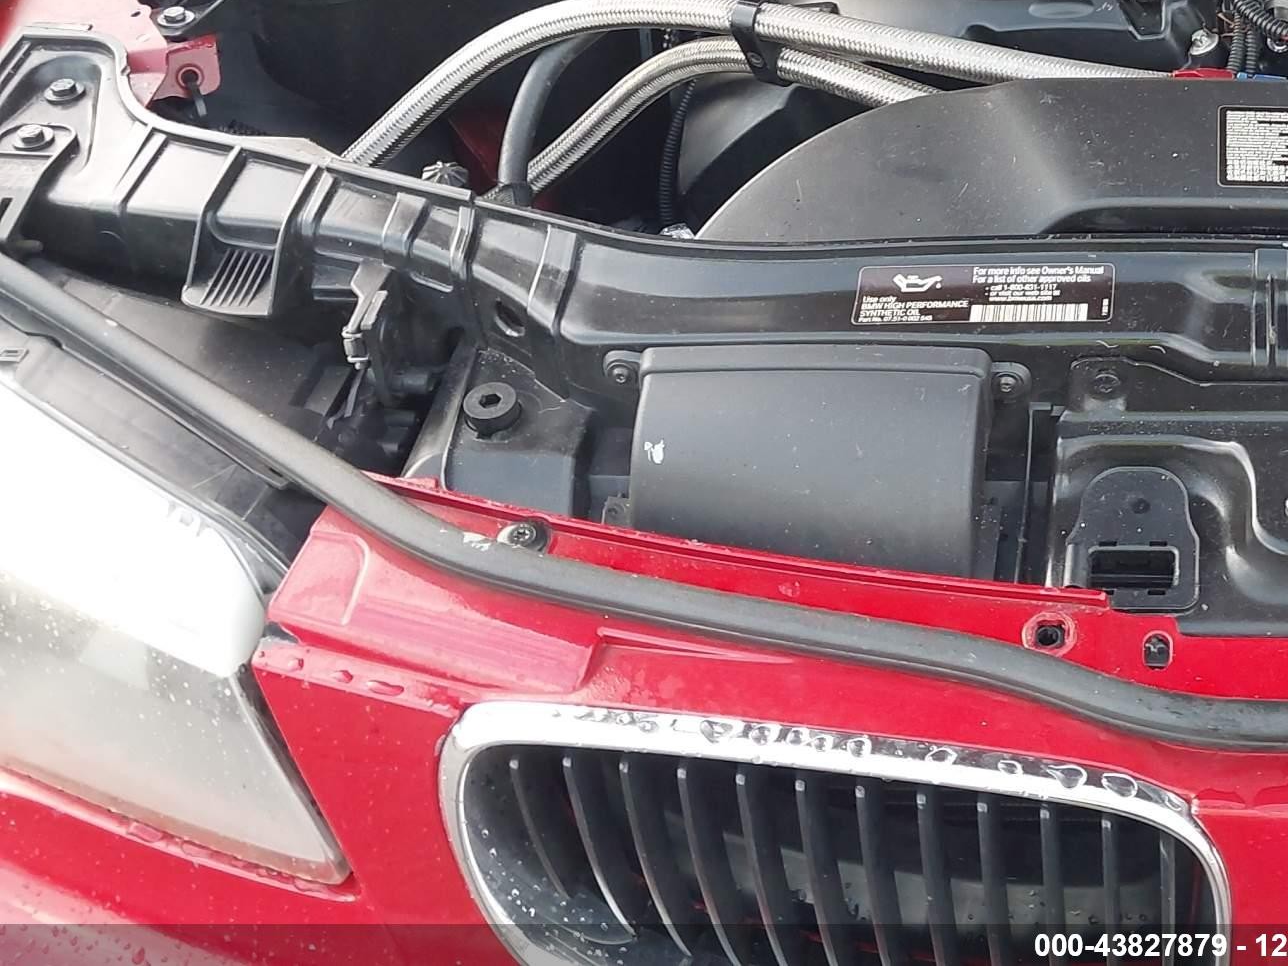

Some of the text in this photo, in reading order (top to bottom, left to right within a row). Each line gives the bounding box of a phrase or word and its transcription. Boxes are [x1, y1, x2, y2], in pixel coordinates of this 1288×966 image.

[973, 265, 1104, 275] For more info see Owner's Manual
[972, 275, 987, 283] For
[994, 275, 1006, 283] list
[1007, 275, 1016, 283] of
[1016, 275, 1039, 283] other
[1039, 275, 1076, 284] approved
[1077, 274, 1092, 283] oils
[879, 296, 898, 304] only
[906, 300, 969, 309] PERFORMANCE
[860, 309, 906, 317] SYNTHETIC
